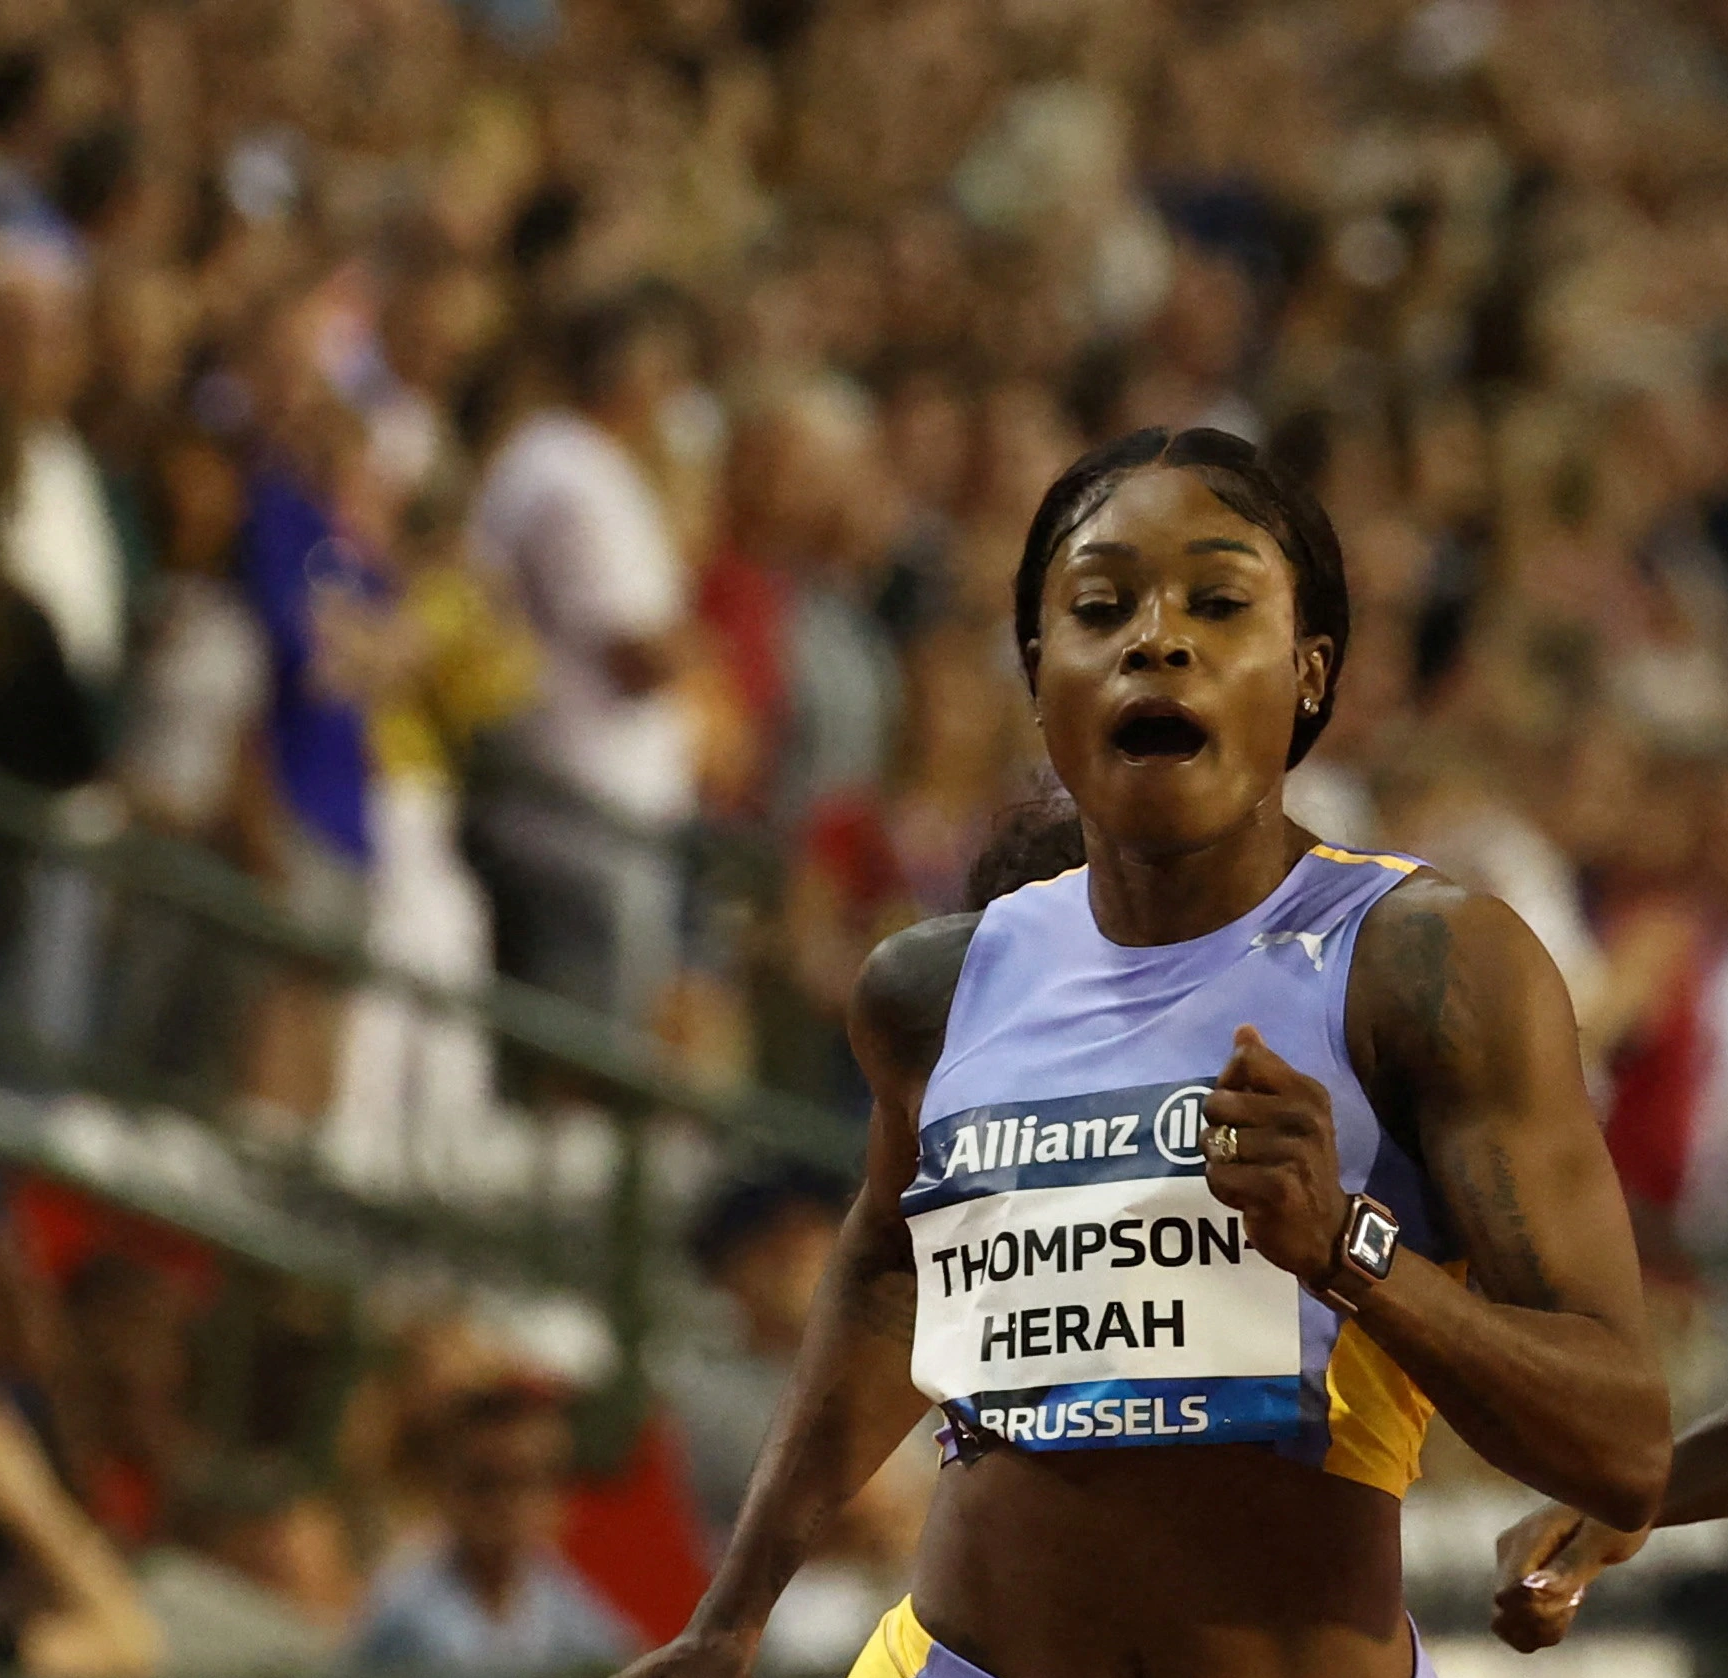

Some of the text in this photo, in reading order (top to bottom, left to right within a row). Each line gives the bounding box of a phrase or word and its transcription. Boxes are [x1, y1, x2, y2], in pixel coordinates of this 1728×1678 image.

[943, 1114, 1139, 1179] Allianz
[980, 1299, 1185, 1362] HERAH
[980, 1395, 1209, 1442] BRUSSELS
